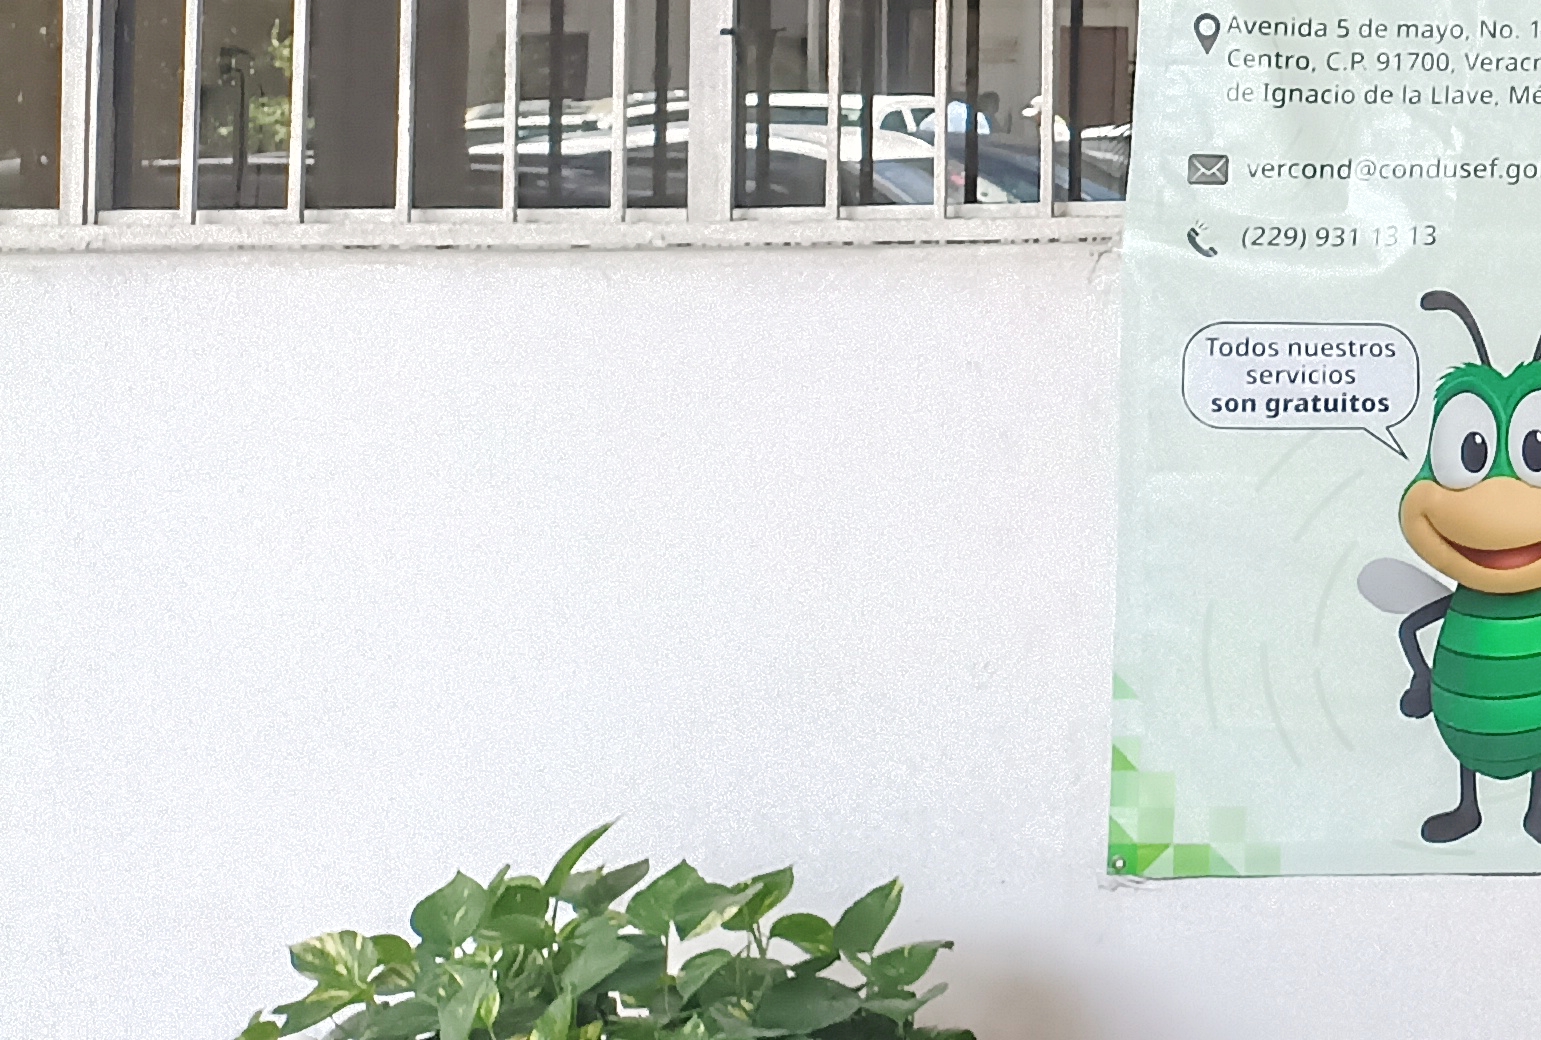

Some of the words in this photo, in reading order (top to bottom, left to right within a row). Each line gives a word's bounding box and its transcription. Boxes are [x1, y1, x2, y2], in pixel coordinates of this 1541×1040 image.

[1227, 16, 1327, 37] Avenida
[1337, 19, 1349, 38] 5
[1359, 19, 1387, 38] de
[1397, 22, 1469, 44] mayo,
[1481, 20, 1519, 39] No.
[1227, 49, 1316, 72] Centro,
[1377, 52, 1455, 74] 91700,
[1226, 83, 1254, 102] de
[1264, 83, 1355, 108] Ignacio
[1364, 85, 1393, 104] de
[1402, 85, 1421, 104] la
[1432, 85, 1499, 107] Llave,
[1241, 225, 1307, 250] (229)
[1314, 225, 1358, 247] 931
[1373, 226, 1398, 247] 13
[1410, 225, 1436, 246] 13
[1205, 337, 1279, 358] Todos
[1288, 338, 1396, 358] nuestros
[1245, 365, 1356, 385] servicios
[1211, 395, 1256, 413] son
[1266, 392, 1390, 418] gratuitos
